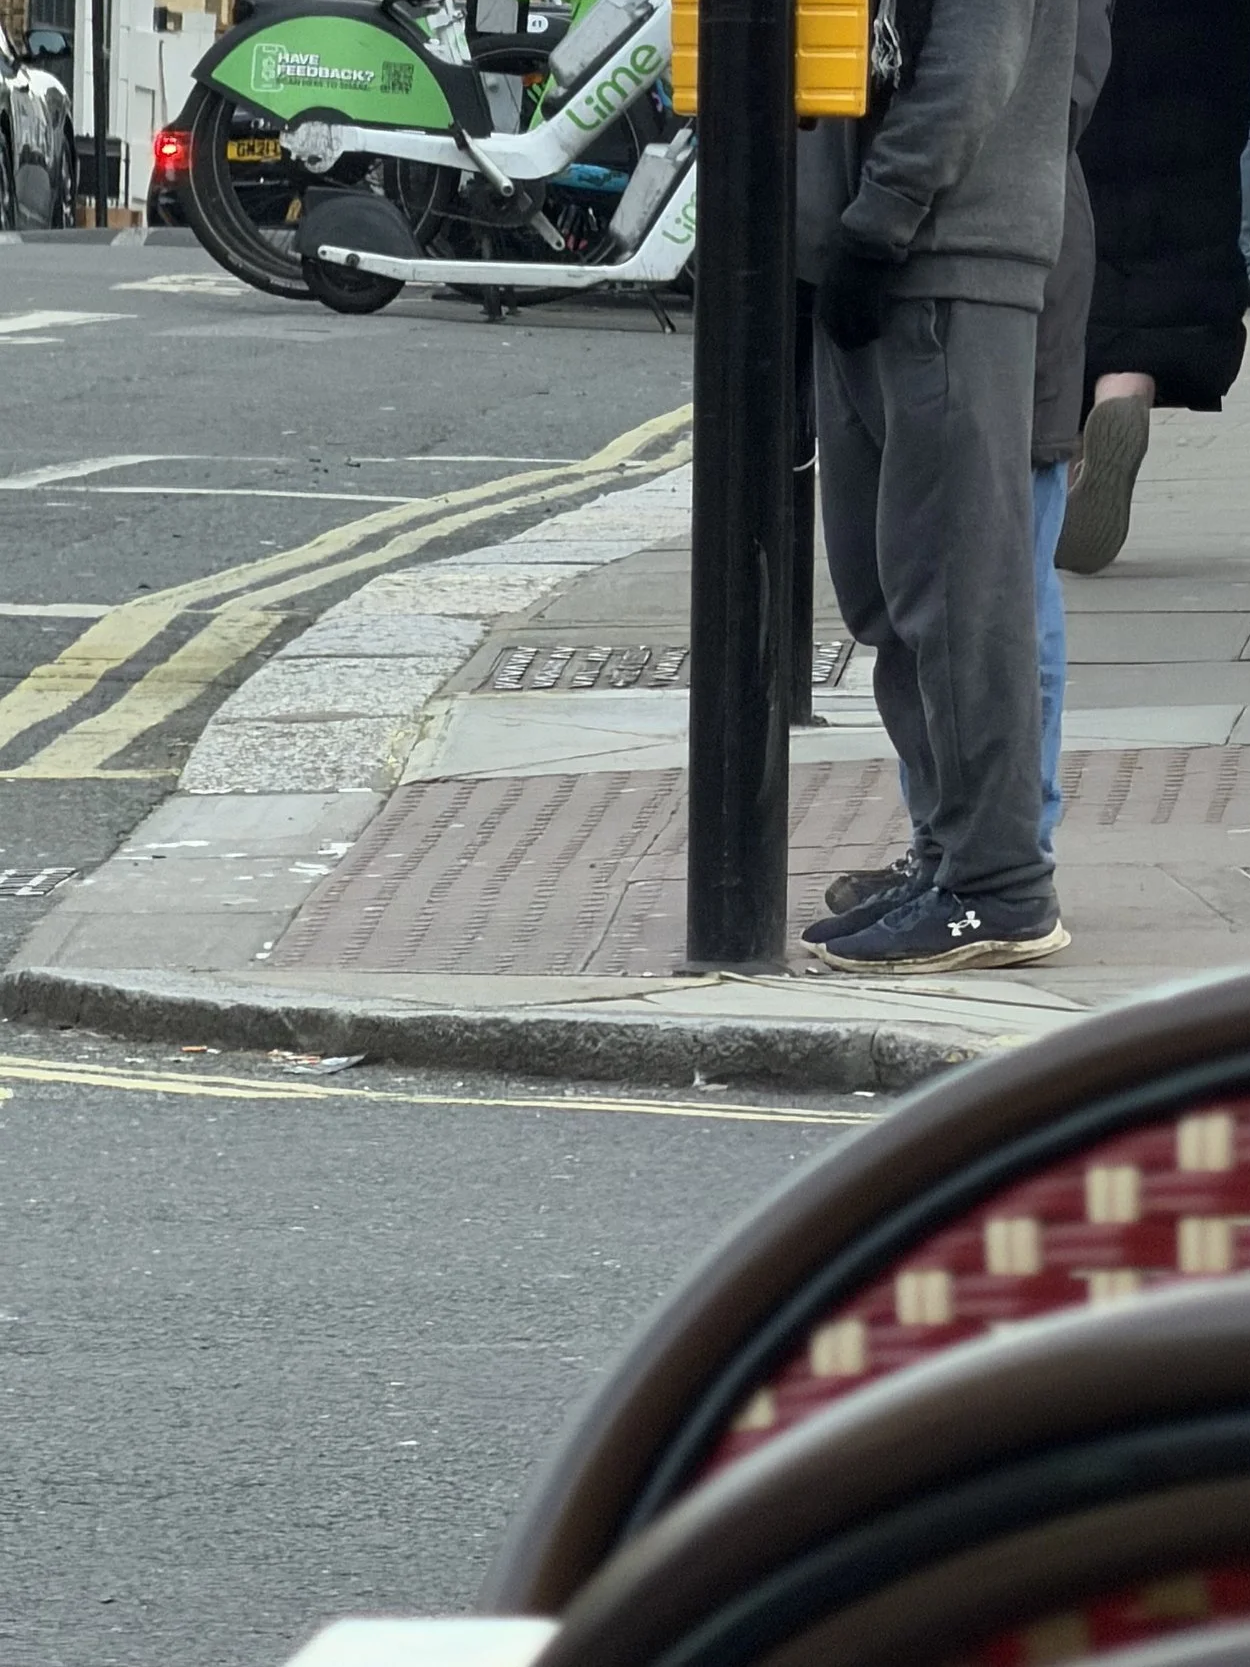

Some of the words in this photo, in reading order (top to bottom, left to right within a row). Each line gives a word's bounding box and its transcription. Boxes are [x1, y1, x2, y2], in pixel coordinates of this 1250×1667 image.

[277, 53, 321, 65] HAVE
[276, 65, 375, 82] FEEDBACK?
[565, 44, 663, 131] Lime
